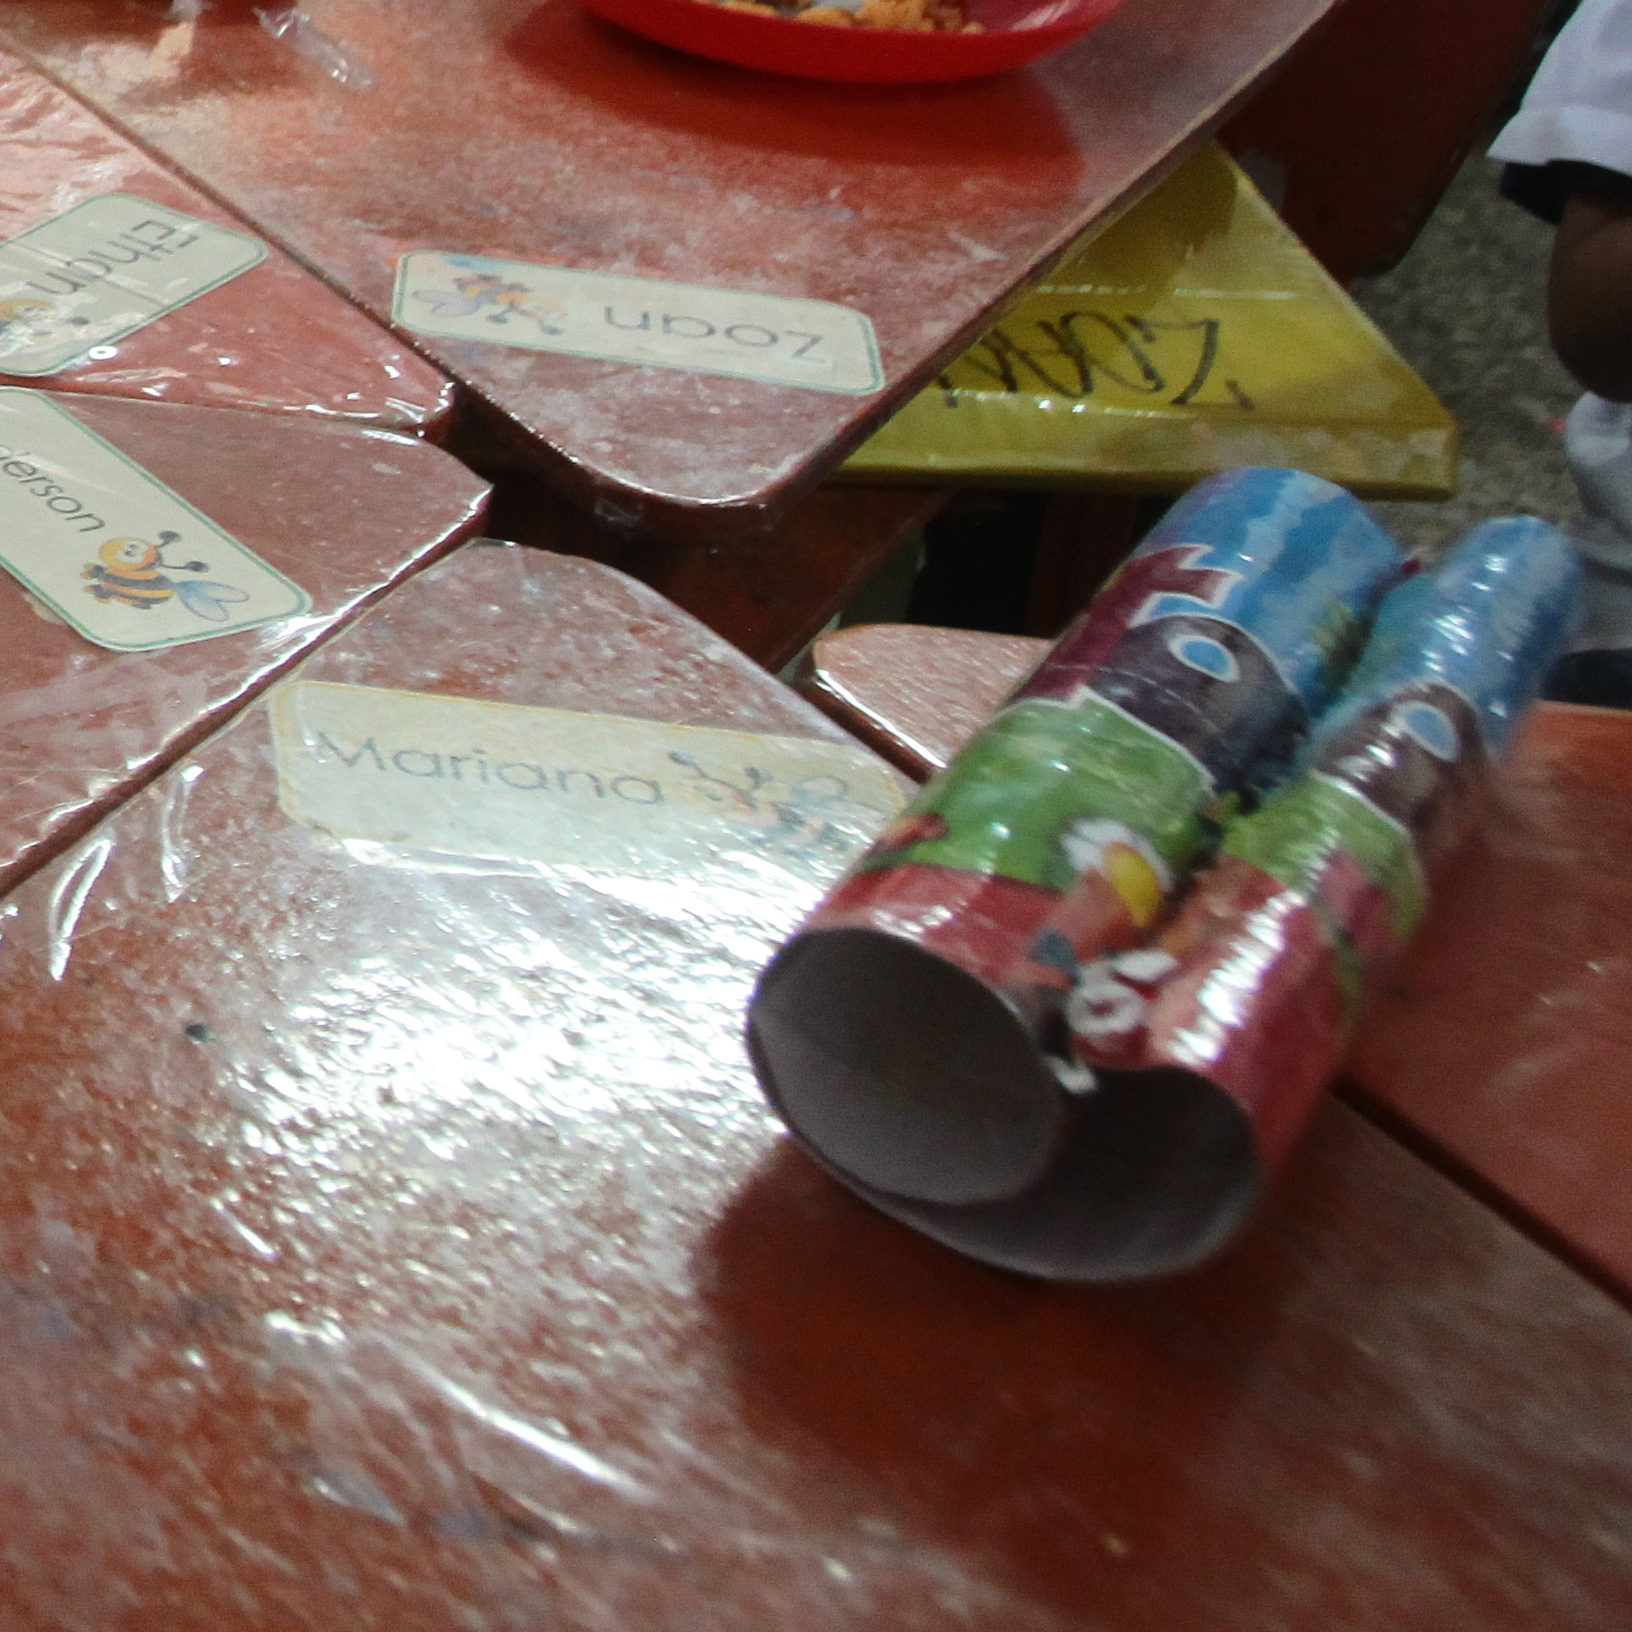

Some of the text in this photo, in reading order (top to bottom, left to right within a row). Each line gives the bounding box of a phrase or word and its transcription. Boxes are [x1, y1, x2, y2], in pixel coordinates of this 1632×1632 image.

[28, 220, 198, 295] Ethan
[605, 305, 826, 362] Zoan
[318, 731, 665, 807] Mariana
